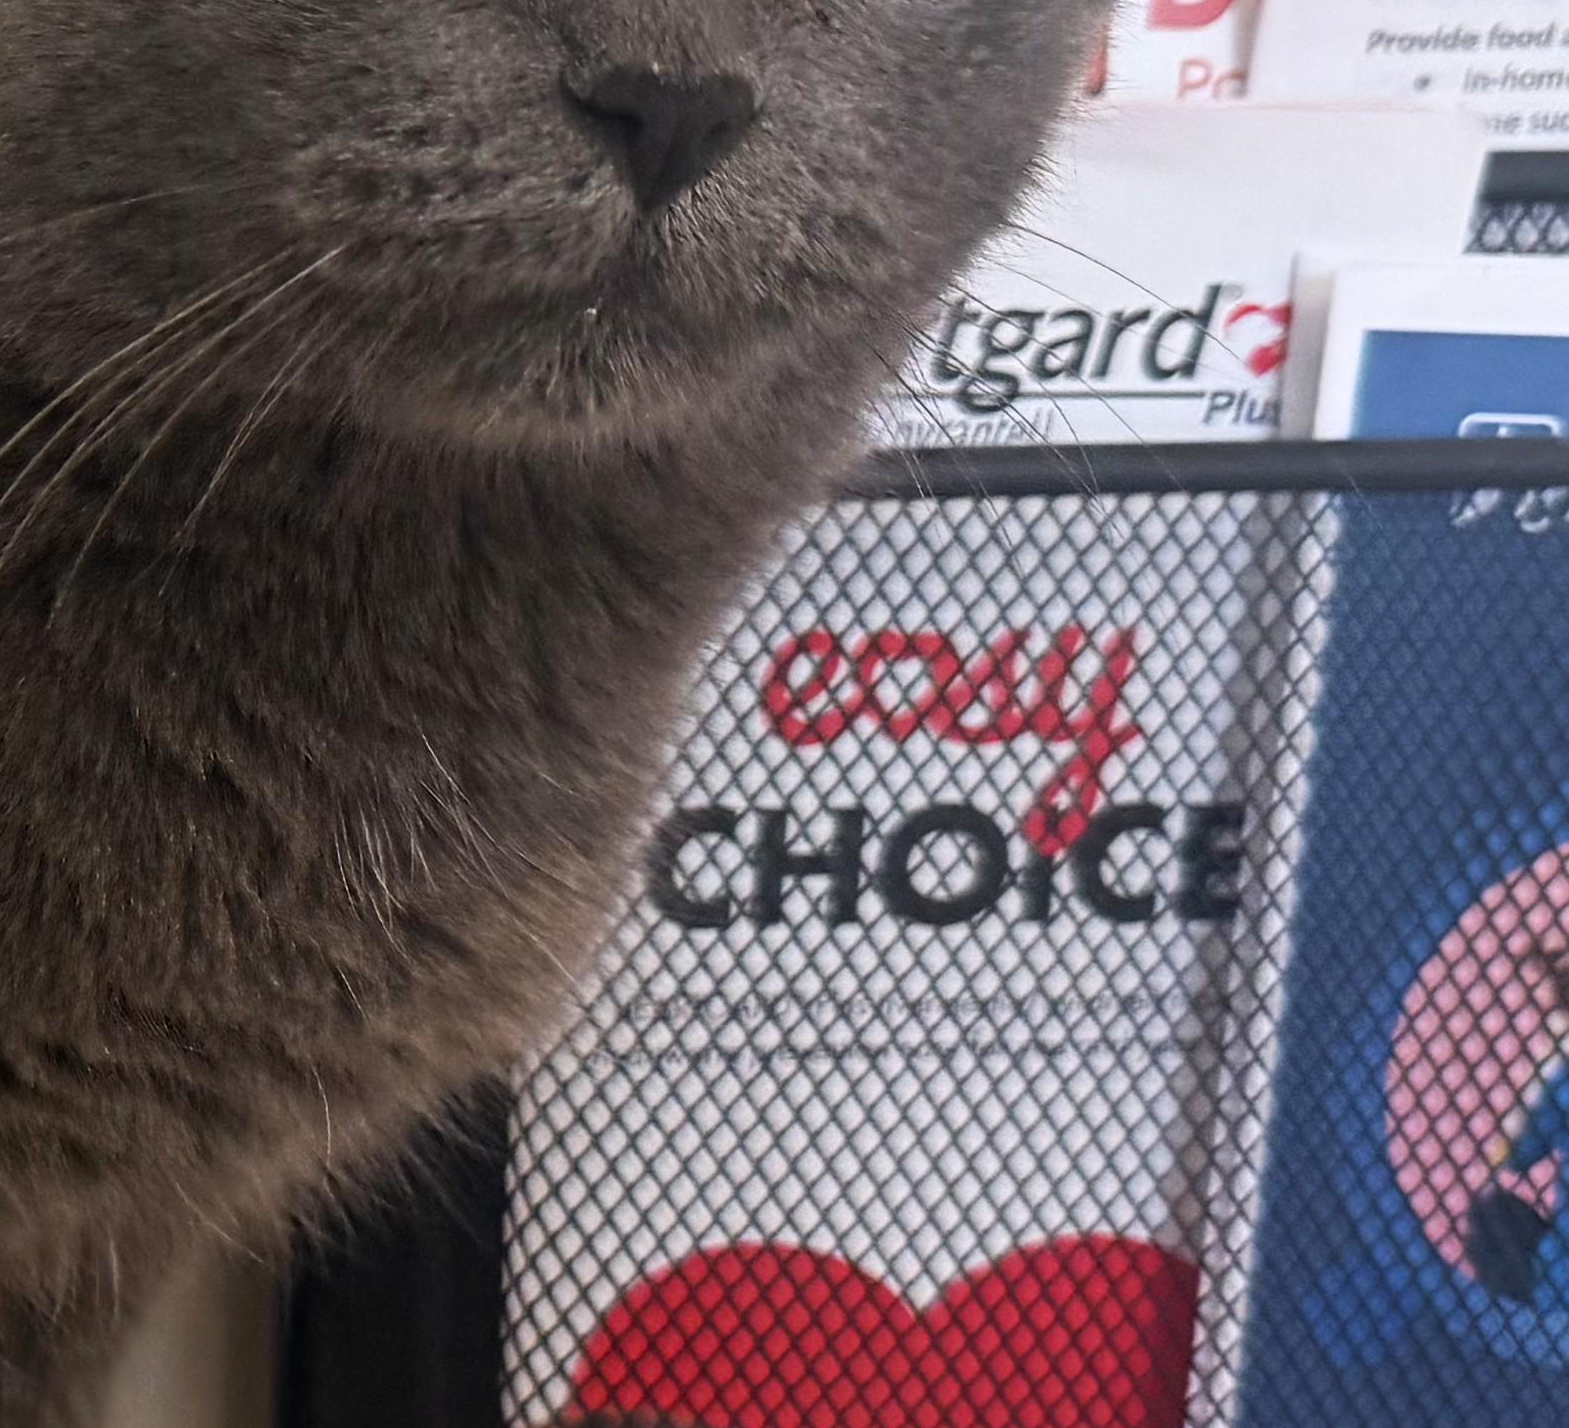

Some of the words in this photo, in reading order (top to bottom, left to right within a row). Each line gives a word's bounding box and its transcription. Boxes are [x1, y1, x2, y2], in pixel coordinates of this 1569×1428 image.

[1365, 24, 1481, 54] Provide
[1486, 20, 1556, 50] food
[1463, 61, 1569, 92] in-hom
[648, 801, 1245, 928] CHOICE
